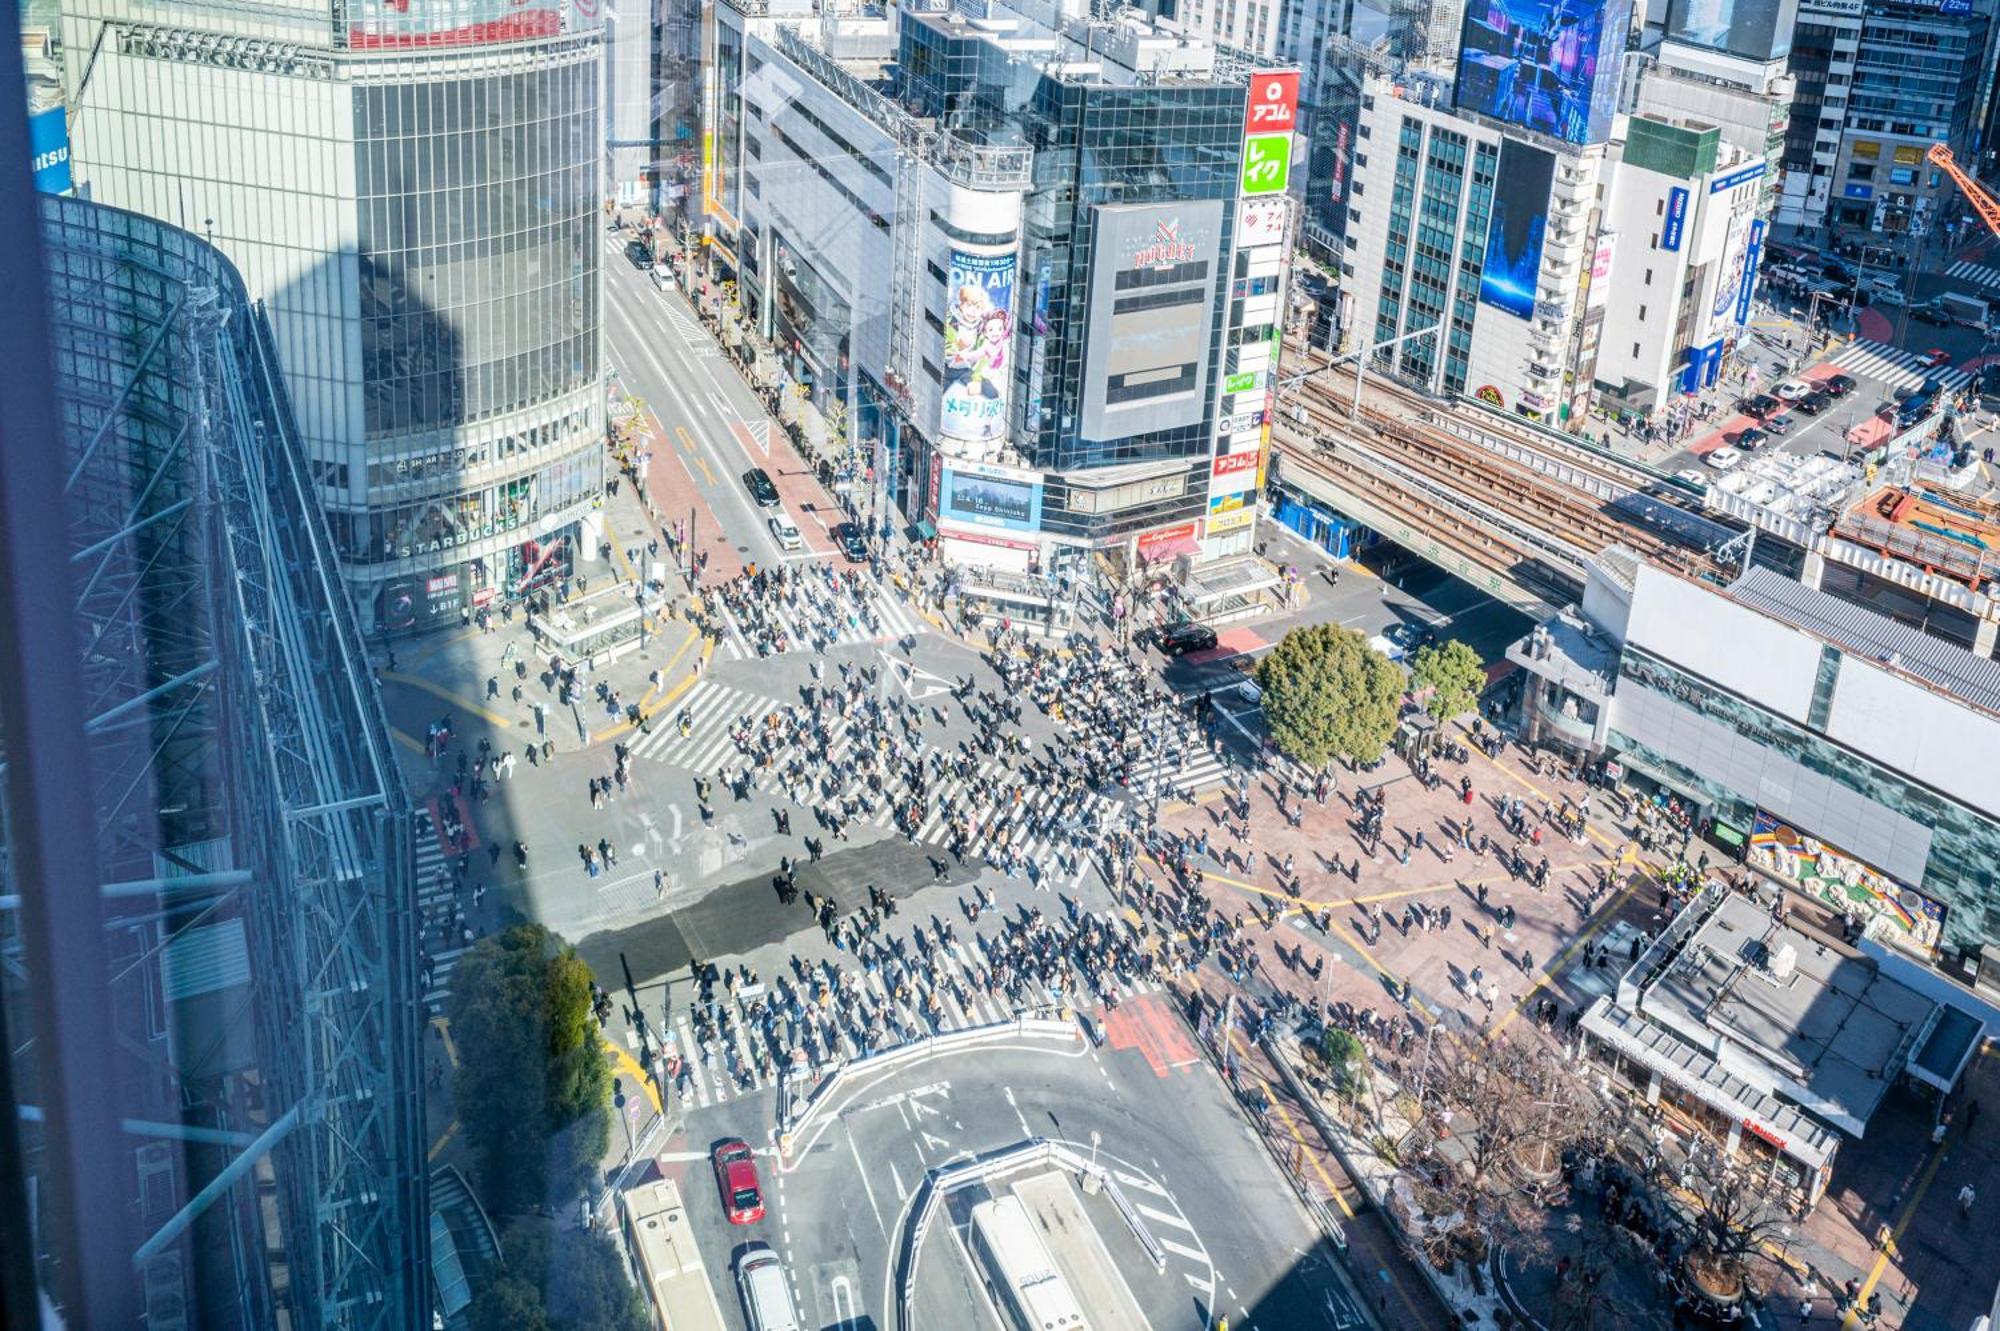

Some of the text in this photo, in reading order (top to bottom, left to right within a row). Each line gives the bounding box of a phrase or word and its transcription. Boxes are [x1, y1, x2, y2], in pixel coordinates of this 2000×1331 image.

[1253, 103, 1290, 122] アコム
[949, 268, 1014, 289] ON AIR
[1218, 456, 1246, 471] アコム
[401, 518, 517, 557] STARBUCKS
